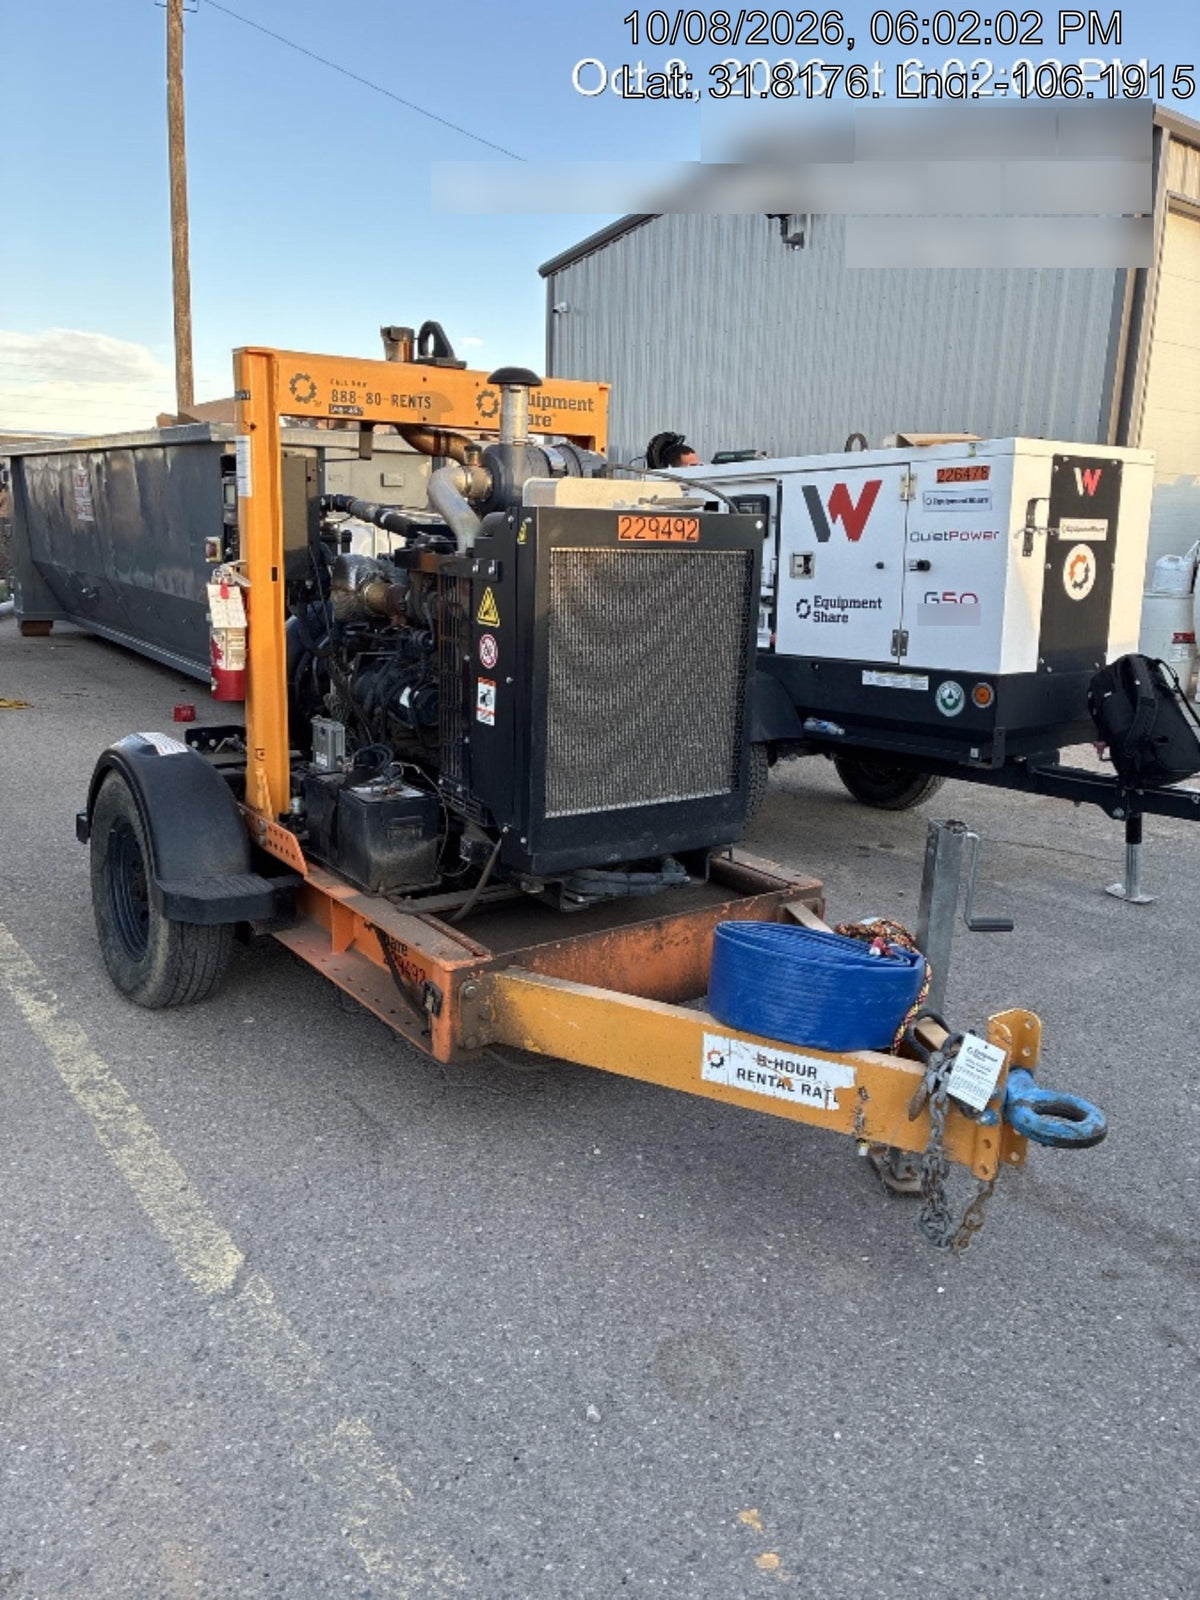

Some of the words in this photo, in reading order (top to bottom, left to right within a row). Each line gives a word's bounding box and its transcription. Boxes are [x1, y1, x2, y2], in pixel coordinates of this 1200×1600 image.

[528, 392, 594, 412] uipment
[528, 413, 552, 427] are
[620, 516, 698, 540] 229492
[910, 531, 1000, 542] QuietPower
[813, 595, 882, 611] Equipment
[813, 611, 849, 624] Share
